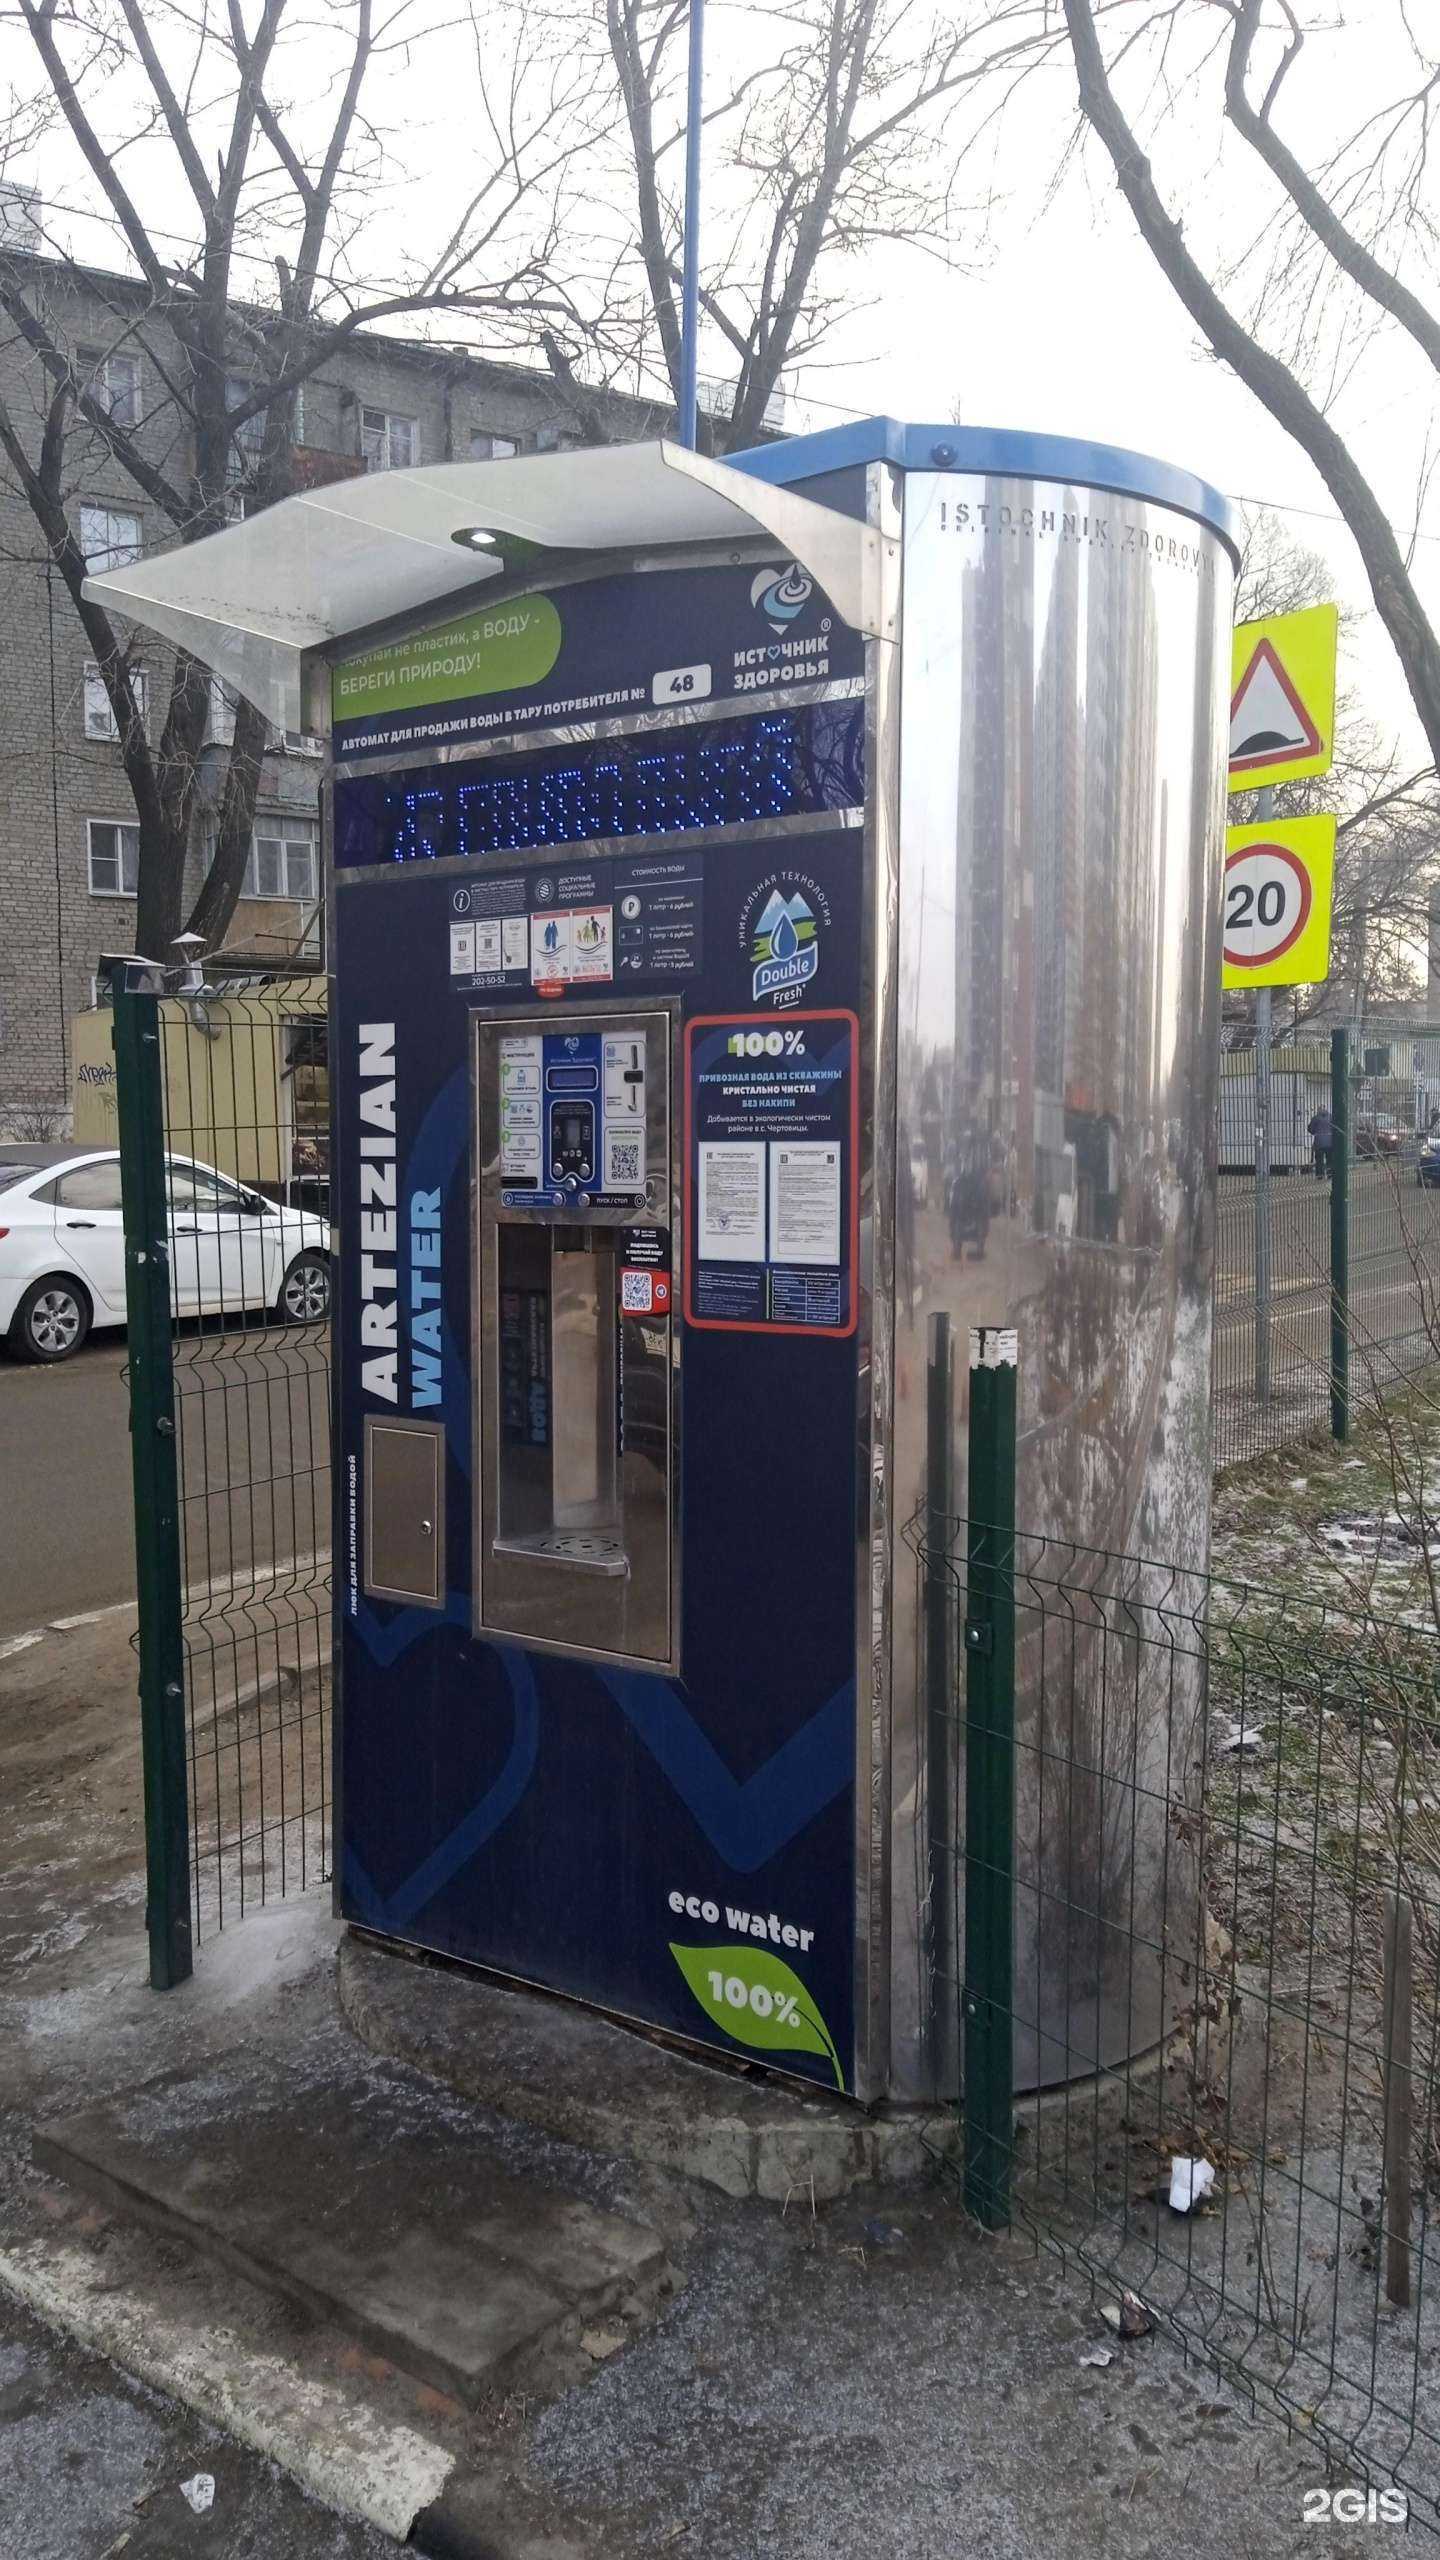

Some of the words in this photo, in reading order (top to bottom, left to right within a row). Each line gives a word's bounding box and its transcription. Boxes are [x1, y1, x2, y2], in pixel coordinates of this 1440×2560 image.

[940, 502, 1108, 540] ISTOCHNIK
[395, 643, 409, 658] не
[472, 630, 481, 641] а
[483, 614, 531, 639] ВОДУ
[340, 671, 397, 696] БЕРЕГИ
[400, 653, 482, 685] ПРИРОДУ!
[734, 658, 830, 690] ЗДОРОВЬЯ
[342, 732, 391, 750] АВТОМАТ
[390, 727, 413, 744] ДЛЯ
[413, 719, 469, 738] ПРОДАЖИ
[470, 711, 503, 728] ВОДЫ
[505, 710, 513, 722] В
[513, 705, 543, 721] ТАРУ
[544, 690, 630, 716] ПОТРЕБИТЕЛЯ
[631, 688, 646, 701] №
[669, 674, 695, 694] 48
[738, 873, 777, 949] УНИКАЛЬНАЯ
[781, 871, 832, 927] ТЕХНОЛОГИЯ
[1225, 881, 1286, 929] 20
[761, 960, 809, 986] Double
[773, 986, 803, 1005] Fresh
[732, 1030, 806, 1057] 100%
[699, 1073, 749, 1083] ПРИВОЗНАЯ
[750, 1073, 776, 1082] ВОДА
[776, 1072, 788, 1080] ИЗ
[789, 1070, 842, 1080] СКВАЖИНЫ
[722, 1086, 781, 1096] КРИСТАЛЬНО
[781, 1084, 816, 1094] ЧИСТАЯ
[707, 1115, 748, 1124] Добывается
[755, 1115, 804, 1124] экологически
[804, 1114, 832, 1122] чистом
[742, 1099, 758, 1108] БЕЗ
[759, 1099, 796, 1108] НАКИПИ
[728, 1125, 753, 1134] районе
[359, 1022, 398, 1405] ARTEZIAN
[411, 1186, 442, 1408] WATER
[347, 1455, 356, 1497] ВОДОЙ
[350, 1560, 358, 1584] ДЛЯ
[668, 1891, 720, 1924] eco
[725, 1906, 815, 1952] water
[708, 1970, 801, 2028] 100%
